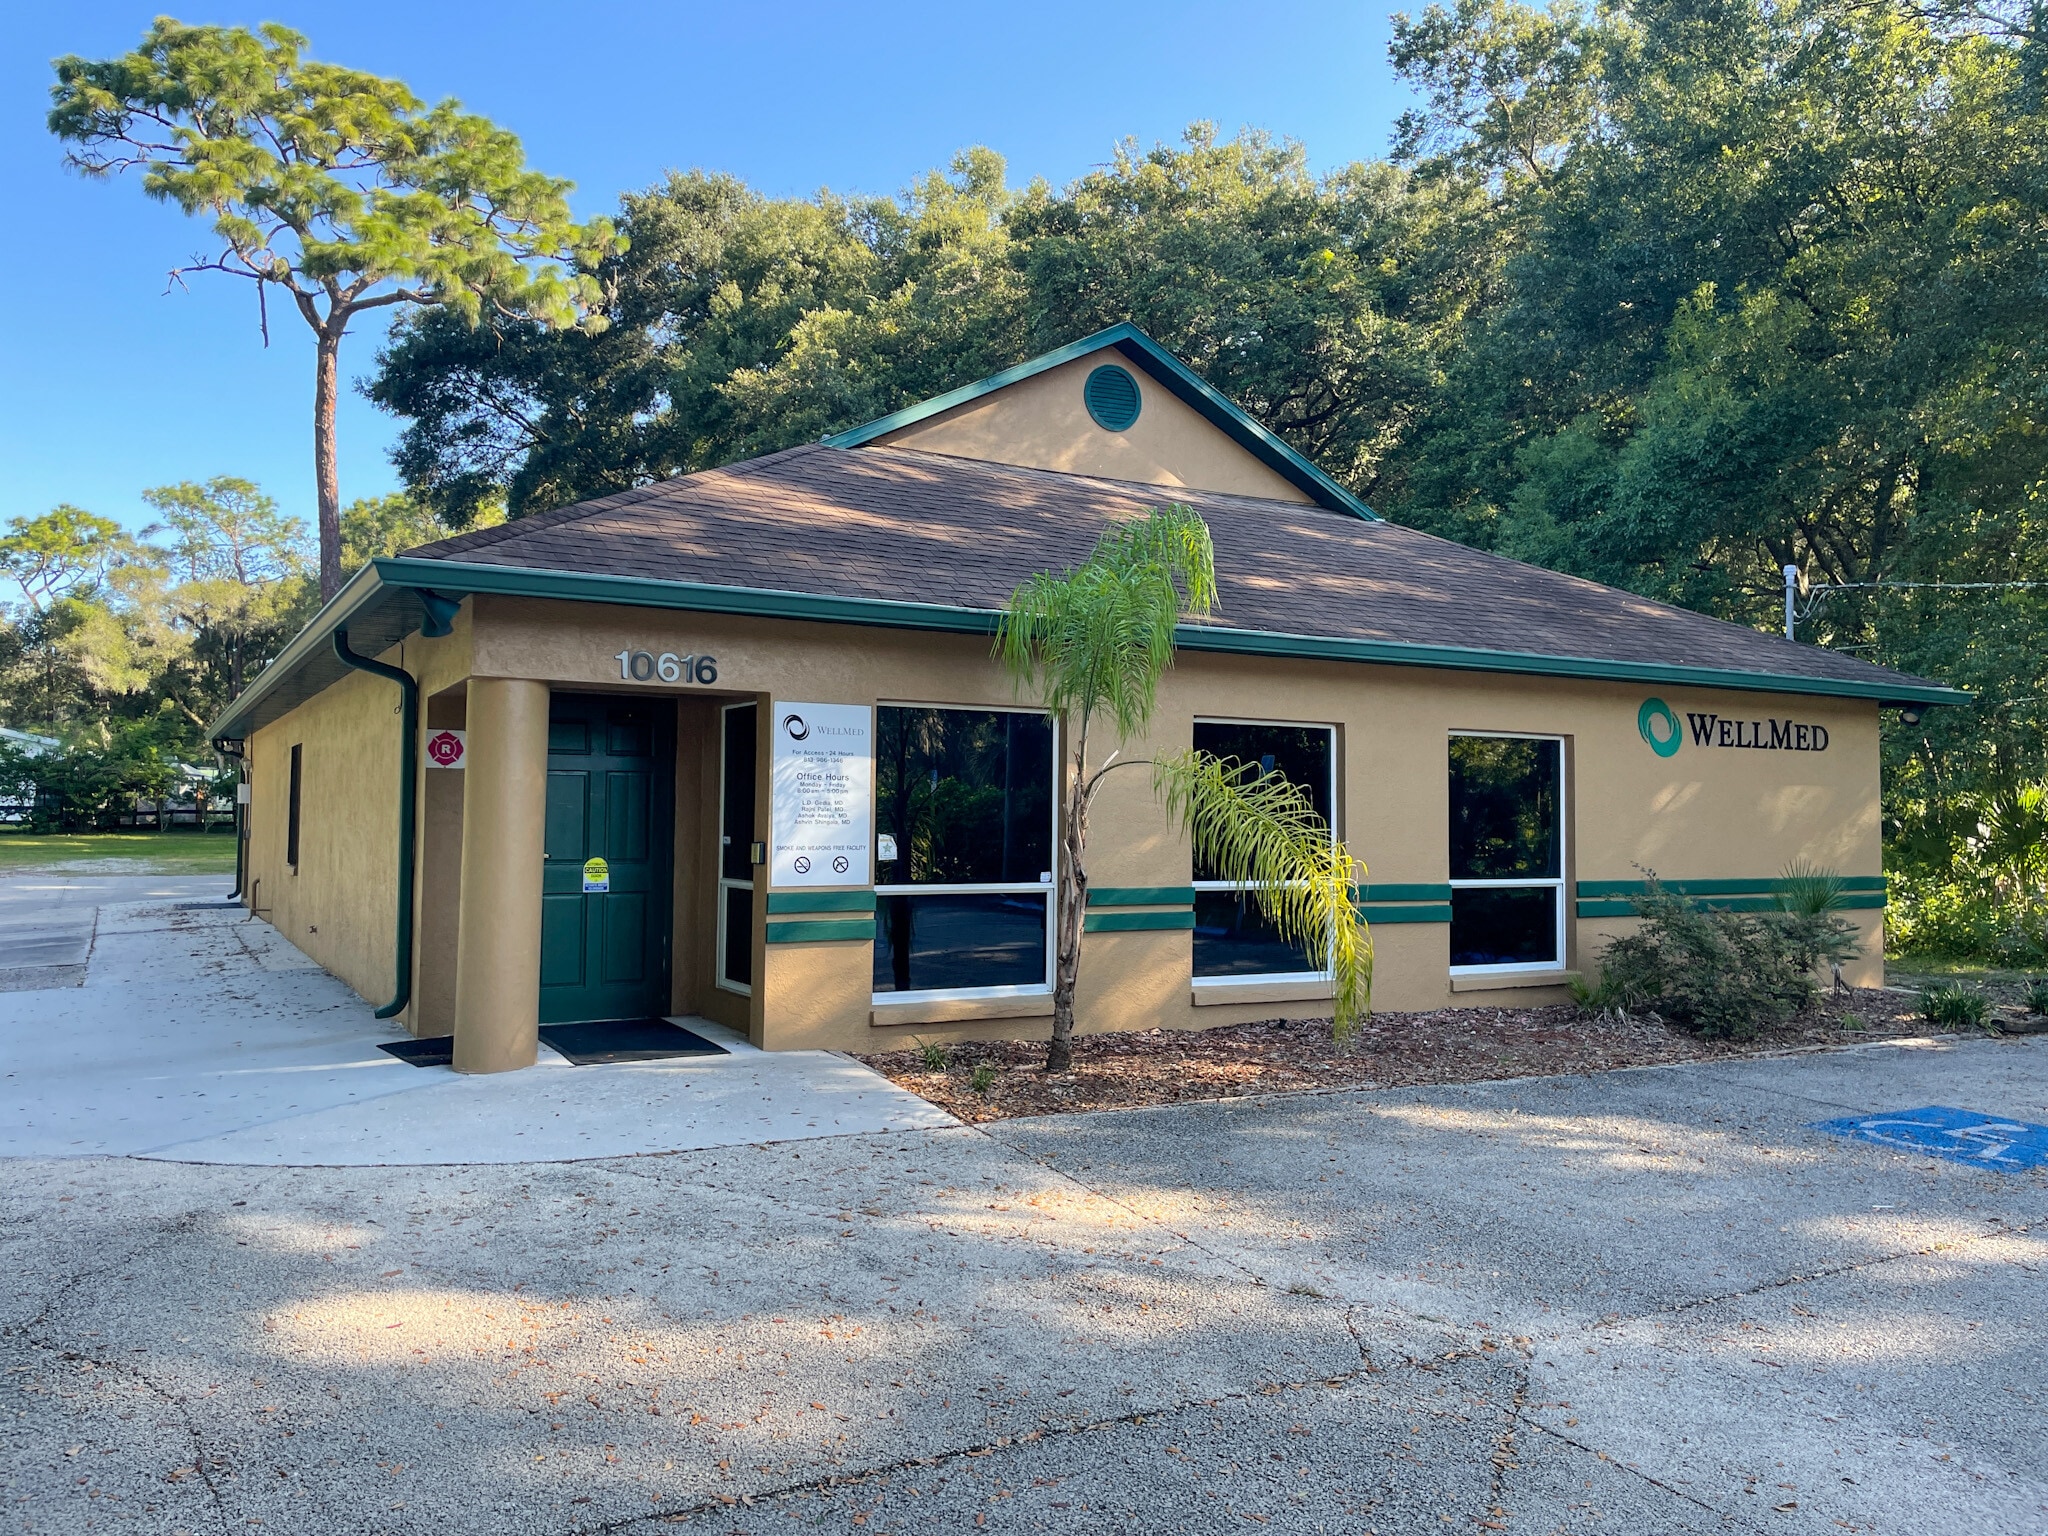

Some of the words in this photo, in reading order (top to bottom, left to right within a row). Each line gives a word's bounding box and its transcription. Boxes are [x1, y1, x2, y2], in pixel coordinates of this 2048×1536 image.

[614, 650, 718, 685] 10616
[441, 744, 451, 754] R
[796, 772, 822, 781] Office
[826, 773, 850, 781] Hours
